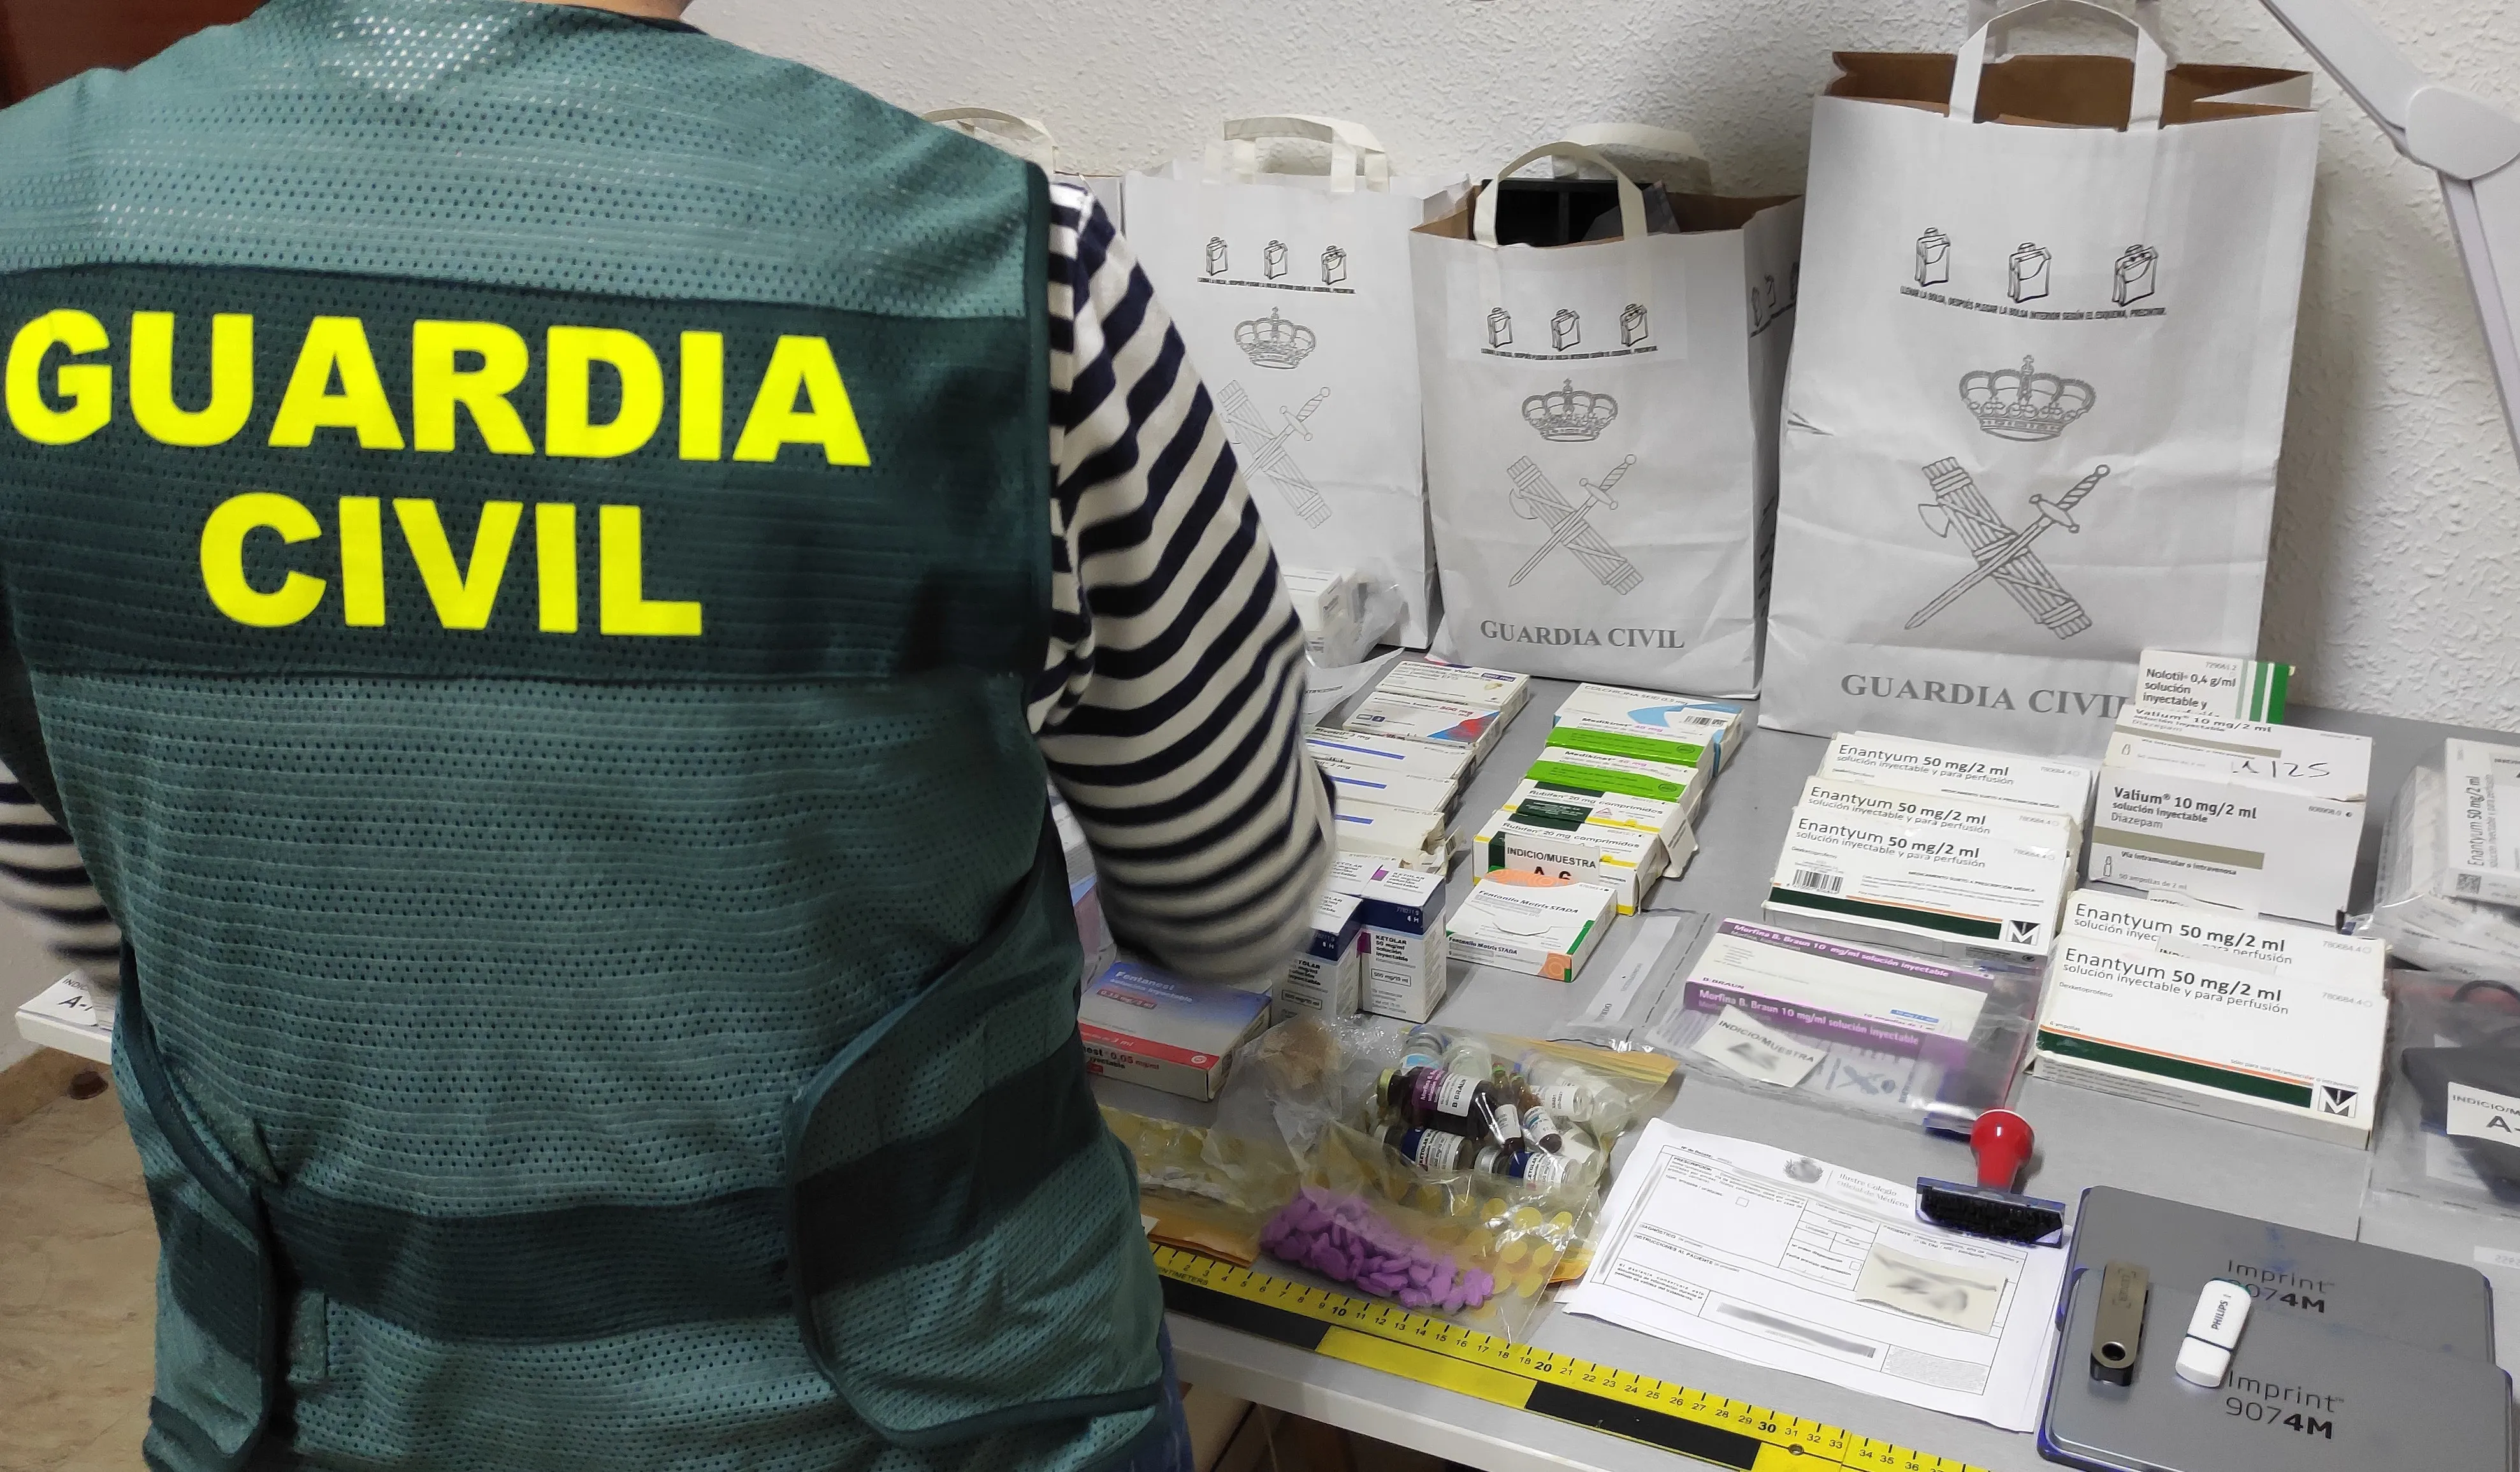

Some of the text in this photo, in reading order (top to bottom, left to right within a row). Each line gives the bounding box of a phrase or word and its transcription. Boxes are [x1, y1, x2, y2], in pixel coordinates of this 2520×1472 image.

[5, 308, 871, 466] GUARDIA
[199, 492, 702, 636] CIVIL
[1480, 619, 1686, 649] GUARDIA CIVIL
[1841, 674, 2016, 711] GUARDIA
[2143, 681, 2192, 695] solución
[2190, 674, 2208, 684] 0,4
[2209, 677, 2236, 688] g/ml
[2142, 691, 2208, 711] inyectable y
[2213, 720, 2250, 730] mg/2
[2255, 725, 2273, 733] ml
[1838, 744, 2009, 776] Enantyum 50 mg/2 ml
[1931, 768, 1938, 777] y
[1939, 770, 1963, 781] para
[1964, 772, 2015, 785] perfusión
[1581, 797, 1597, 805] mg
[1598, 800, 1664, 815] comprimidos
[1807, 797, 1991, 835] solución inyectable y para perfusión
[1810, 786, 1987, 826] Enantyum 50 mg/2 ml
[2111, 802, 2209, 823] solución inyectable
[2111, 812, 2164, 829] Diazepam
[2174, 797, 2192, 809] 10
[2196, 802, 2235, 818] mg/2
[2238, 807, 2257, 819] ml
[1555, 832, 1572, 841] mg
[1573, 835, 1640, 849] comprimidos
[1795, 830, 1986, 869] solución inyectable y para perfusión
[1798, 818, 1981, 860] Enantyum 50 mg/2 ml
[1507, 846, 1597, 869] INDICIO/MUESTRA
[1478, 890, 1519, 904] Fentanilo
[1521, 898, 1550, 911] Matrix
[1549, 905, 1579, 914] STADA
[1375, 934, 1408, 946] KETOLAR
[2073, 918, 2122, 935] solución
[2075, 903, 2173, 935] Enantyum
[2178, 924, 2202, 939] 50
[2206, 931, 2256, 948] mg/2
[2261, 939, 2286, 953] ml
[1448, 936, 1518, 956] Fentanilo Matrix STADA
[1734, 925, 1950, 978] Morfina B. Braun 10 mg/ml solución inyectable
[2062, 963, 2289, 1014] solución inyectable y para perfusión
[2065, 948, 2166, 980] Enantyum
[2171, 970, 2195, 985] 50
[2200, 976, 2252, 995] mg/2
[2257, 988, 2281, 1002] ml
[1698, 988, 1920, 1046] Morfina B. Braun 10 mg/ml solución inyectable
[1718, 1020, 1814, 1063] INDICIO/MUESTRA
[1866, 1182, 1897, 1197] Colegio
[2229, 1279, 2326, 1314] 074M
[2210, 1299, 2229, 1331] PHILIPS
[1182, 1264, 1191, 1273] 2
[1201, 1269, 1210, 1278] 3
[1240, 1280, 1248, 1288] 5
[1258, 1285, 1268, 1294] 6
[1296, 1295, 1305, 1304] 8
[1331, 1305, 1347, 1318] 10
[1355, 1311, 1367, 1320] 11
[1374, 1315, 1387, 1326] 12
[1393, 1321, 1407, 1331] 13
[1414, 1327, 1428, 1338] 14
[1434, 1332, 1448, 1343] 15
[1455, 1338, 1468, 1348] 16
[1476, 1343, 1489, 1354] 17
[1496, 1349, 1510, 1360] 18
[1534, 1359, 1553, 1375] 20
[1559, 1366, 1574, 1376] 21
[1582, 1373, 1597, 1383] 22
[1602, 1377, 1617, 1388] 23
[1624, 1383, 1639, 1395] 24
[1645, 1389, 1661, 1400] 25
[1669, 1395, 1684, 1407] 26
[1691, 1401, 1707, 1412] 27
[1714, 1407, 1730, 1418] 28
[1737, 1413, 1753, 1425] 29
[1756, 1420, 1777, 1434] 30
[1784, 1427, 1799, 1438] 31
[1806, 1433, 1821, 1444] 32
[1828, 1439, 1843, 1450] 33
[1858, 1448, 1874, 1459] 34
[1879, 1454, 1895, 1465] 35
[1904, 1461, 1920, 1472] 36
[2225, 1396, 2333, 1440] 9074M
